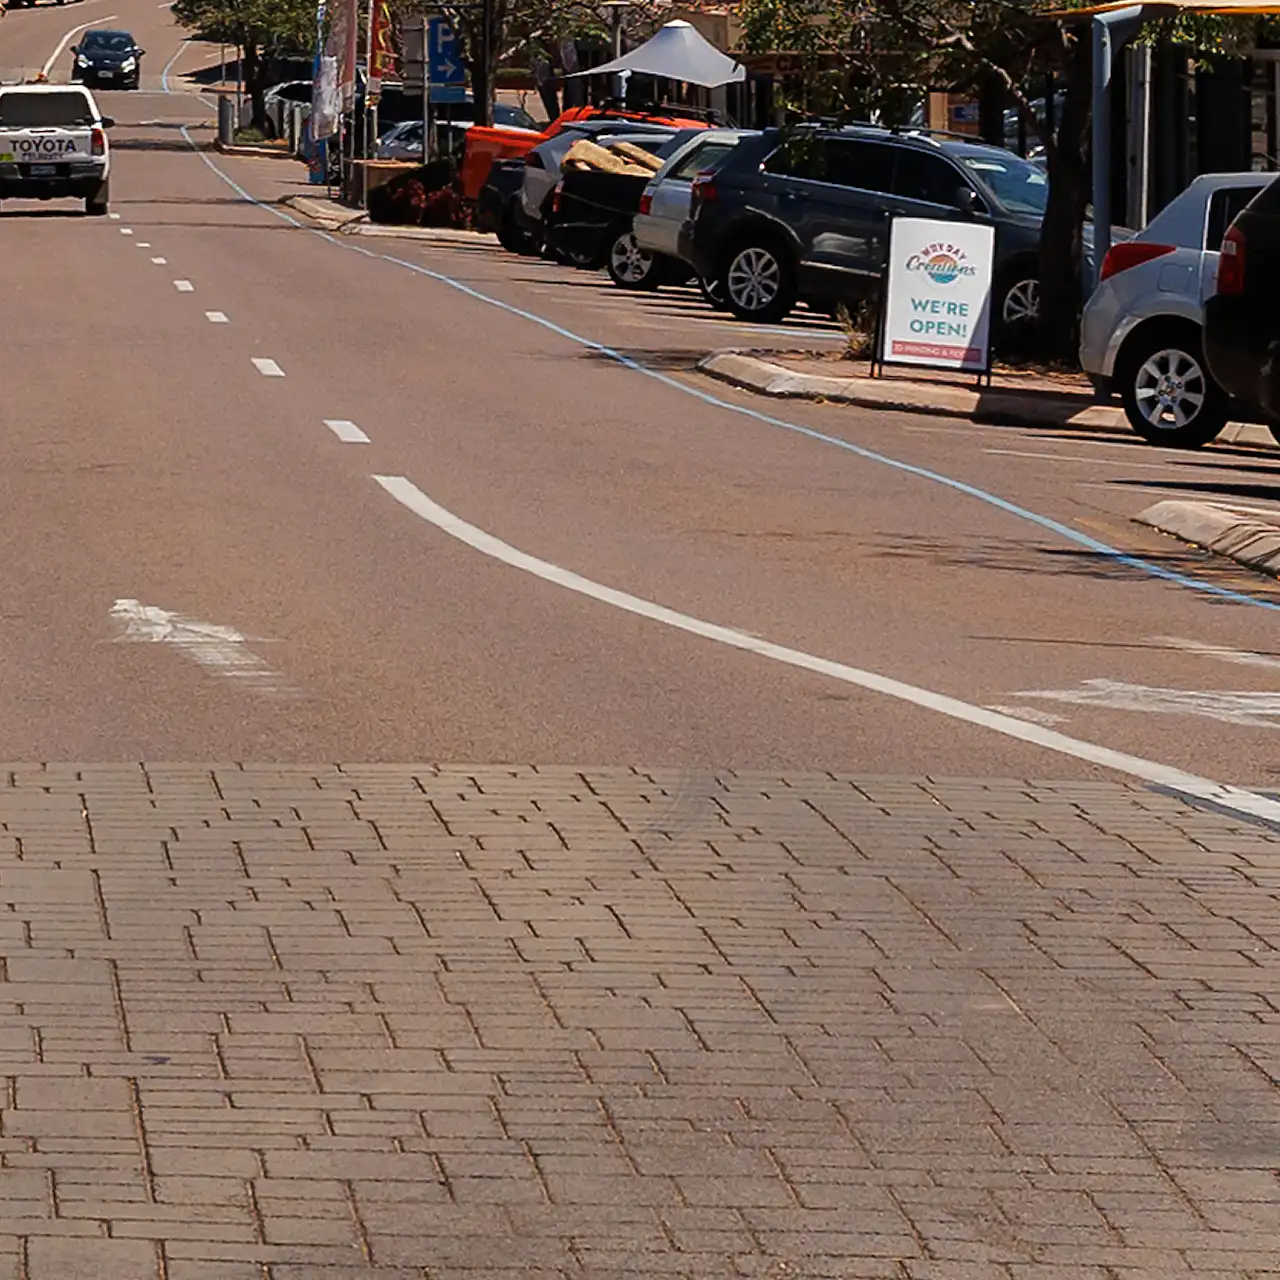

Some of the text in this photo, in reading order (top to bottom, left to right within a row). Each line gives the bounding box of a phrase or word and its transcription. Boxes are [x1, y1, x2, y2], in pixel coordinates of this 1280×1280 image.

[437, 23, 457, 53] P
[10, 138, 76, 152] TOYOTA
[911, 298, 969, 317] WE'RE
[910, 320, 967, 337] OPEN!
